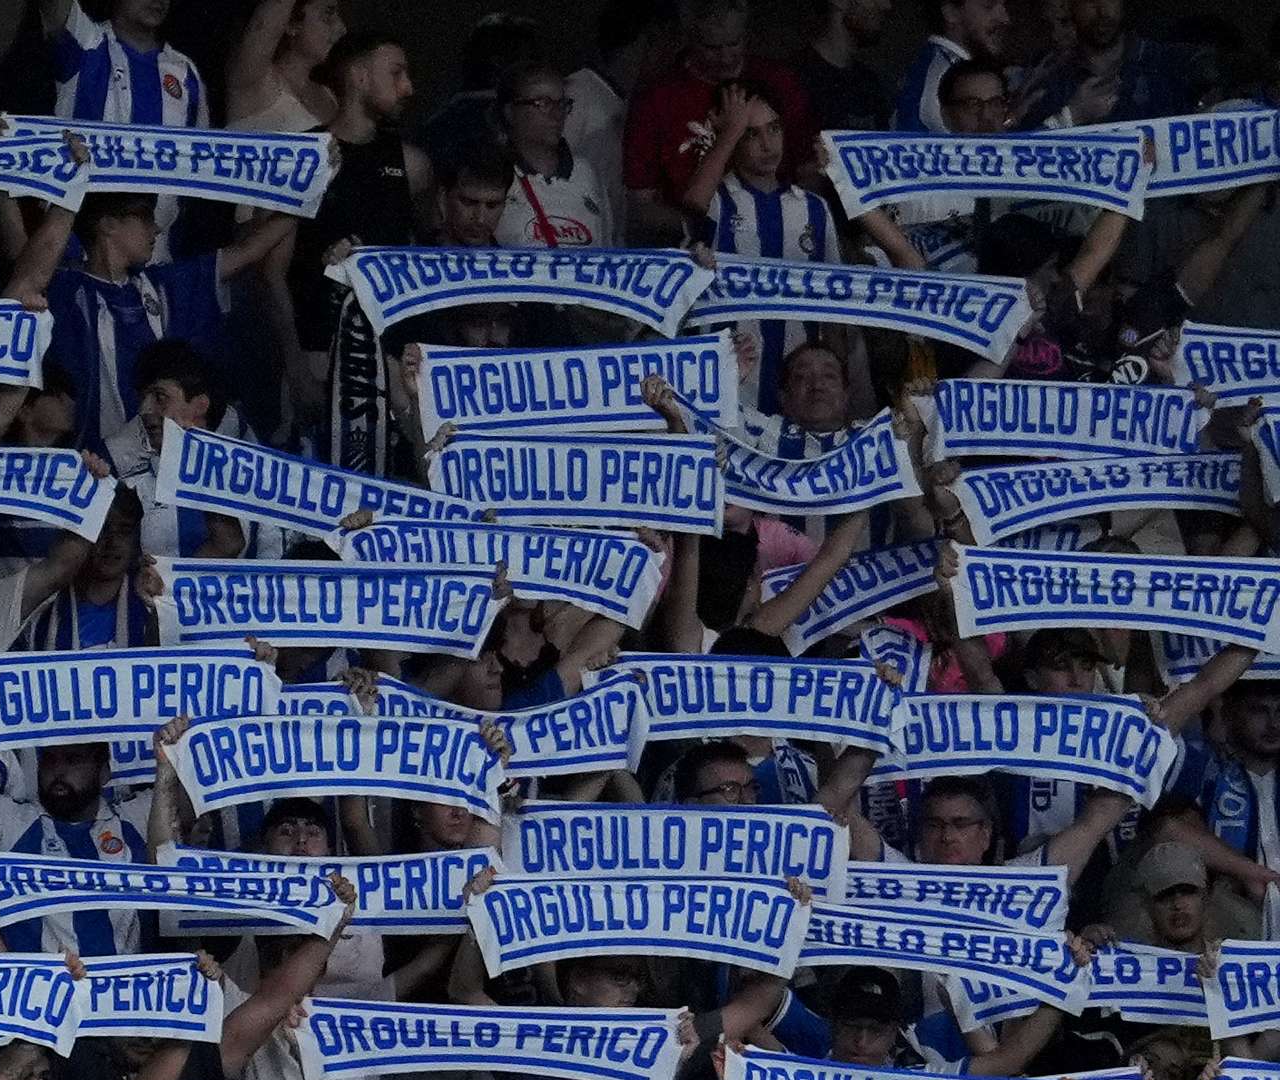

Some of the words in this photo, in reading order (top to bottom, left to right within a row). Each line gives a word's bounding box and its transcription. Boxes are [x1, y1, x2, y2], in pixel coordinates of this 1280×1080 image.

[191, 142, 319, 191] PERICO
[842, 145, 1002, 188] ORGULLO
[1016, 147, 1136, 192] PERICO
[868, 276, 1014, 332] PERICO
[431, 356, 589, 419] ORGULLO
[441, 449, 586, 503] ORGULLO
[601, 451, 714, 511] PERICO
[786, 430, 896, 498] PERICO
[173, 579, 340, 624] ORGULLO
[357, 579, 490, 634] PERICO
[969, 562, 1134, 610] ORGULLO
[1149, 571, 1279, 624] PERICO
[132, 664, 263, 718] PERICO
[192, 724, 360, 787] ORGULLO
[1033, 701, 1158, 778] PERICO
[521, 816, 684, 871] ORGULLO
[701, 818, 831, 879] PERICO
[359, 857, 487, 910] PERICO
[918, 880, 1061, 929] PERICO
[491, 885, 651, 946] ORGULLO
[663, 886, 794, 948] PERICO
[941, 932, 1074, 985] PERICO
[91, 973, 208, 1014] PERICO
[311, 1013, 502, 1058] ORGULLO
[514, 1022, 667, 1070] PERICO
